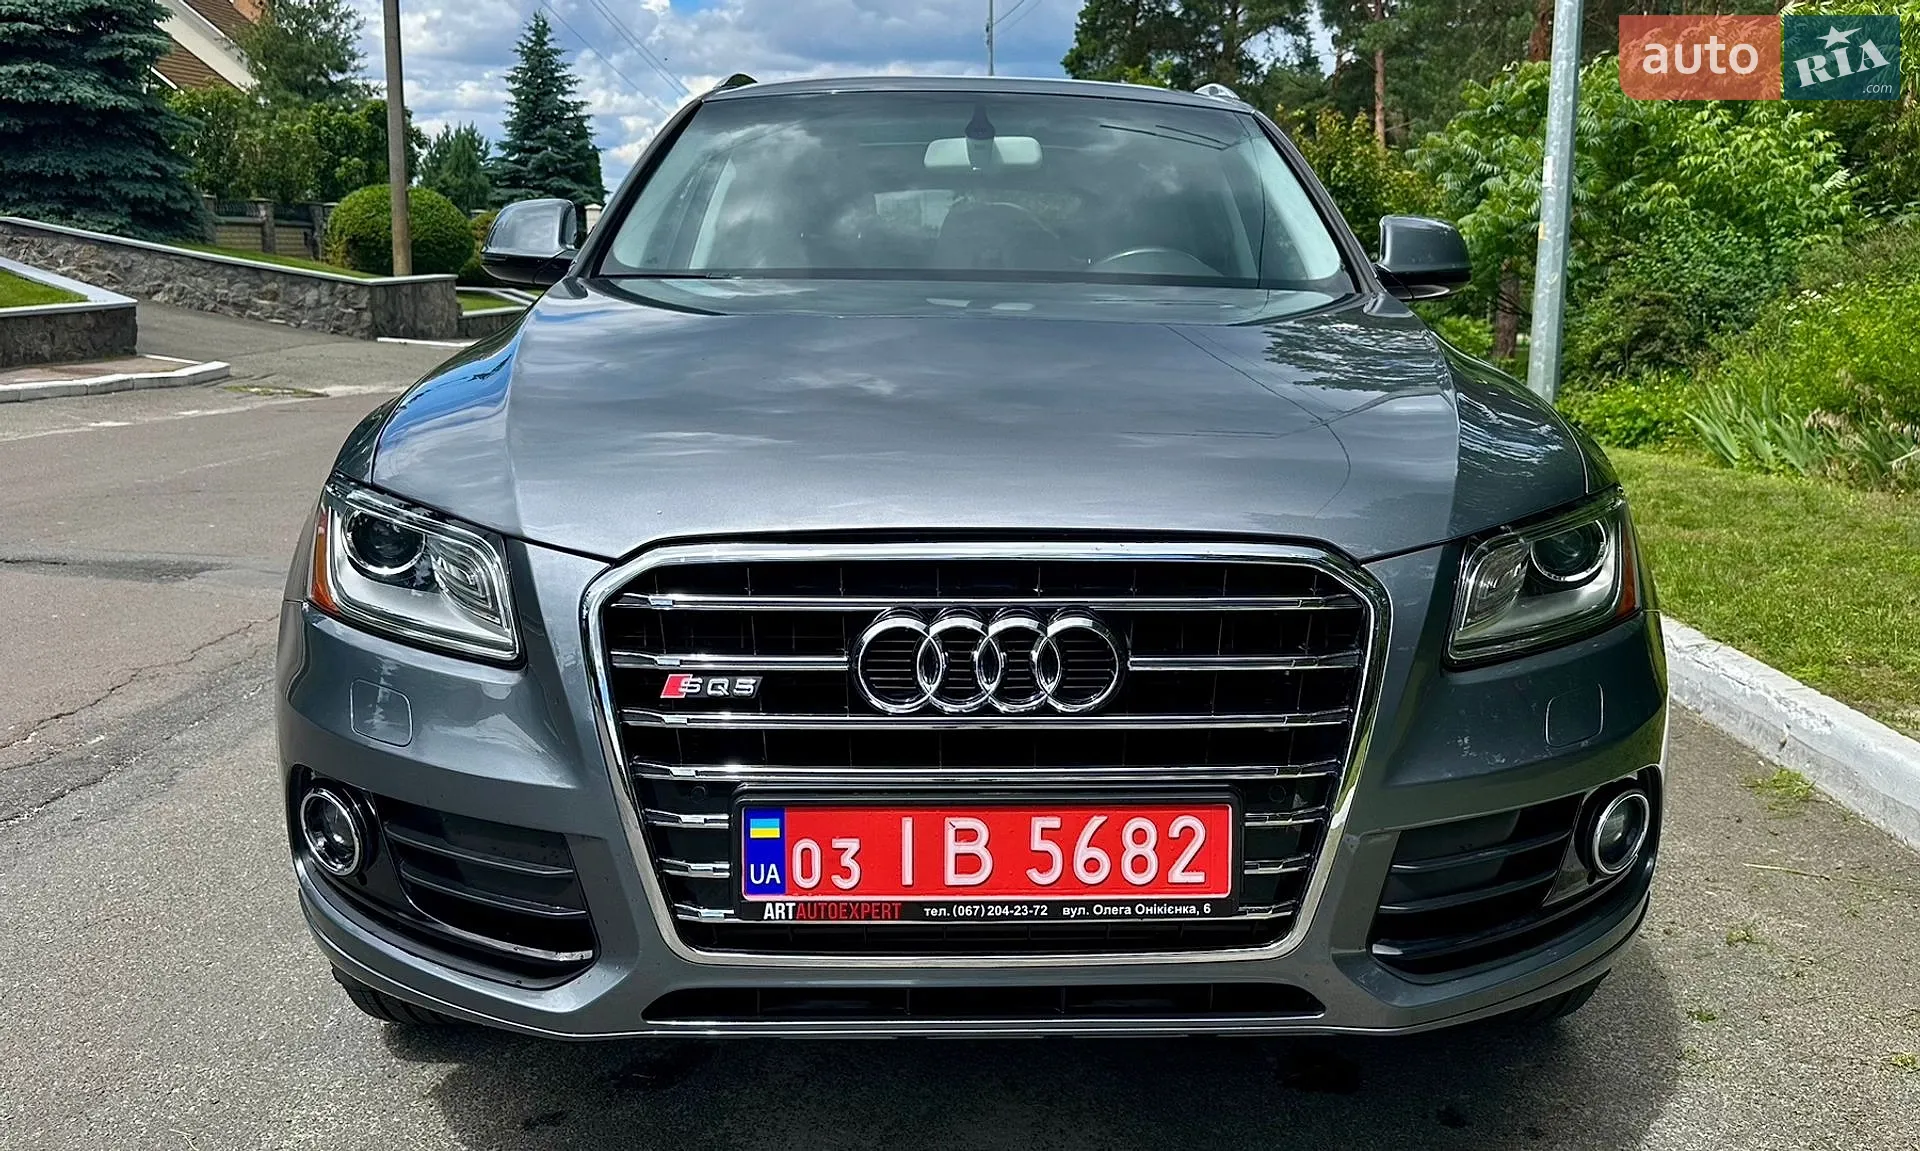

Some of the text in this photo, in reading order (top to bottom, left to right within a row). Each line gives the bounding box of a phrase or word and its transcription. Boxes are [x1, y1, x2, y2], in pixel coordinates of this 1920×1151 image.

[678, 677, 757, 697] SQ5
[792, 838, 862, 889] 03
[1025, 815, 1207, 886] 5682
[750, 863, 781, 885] UA
[923, 904, 1048, 918] тел. (067) 204-23-72
[1062, 903, 1212, 918] вул. Олега Онікієнка, 6
